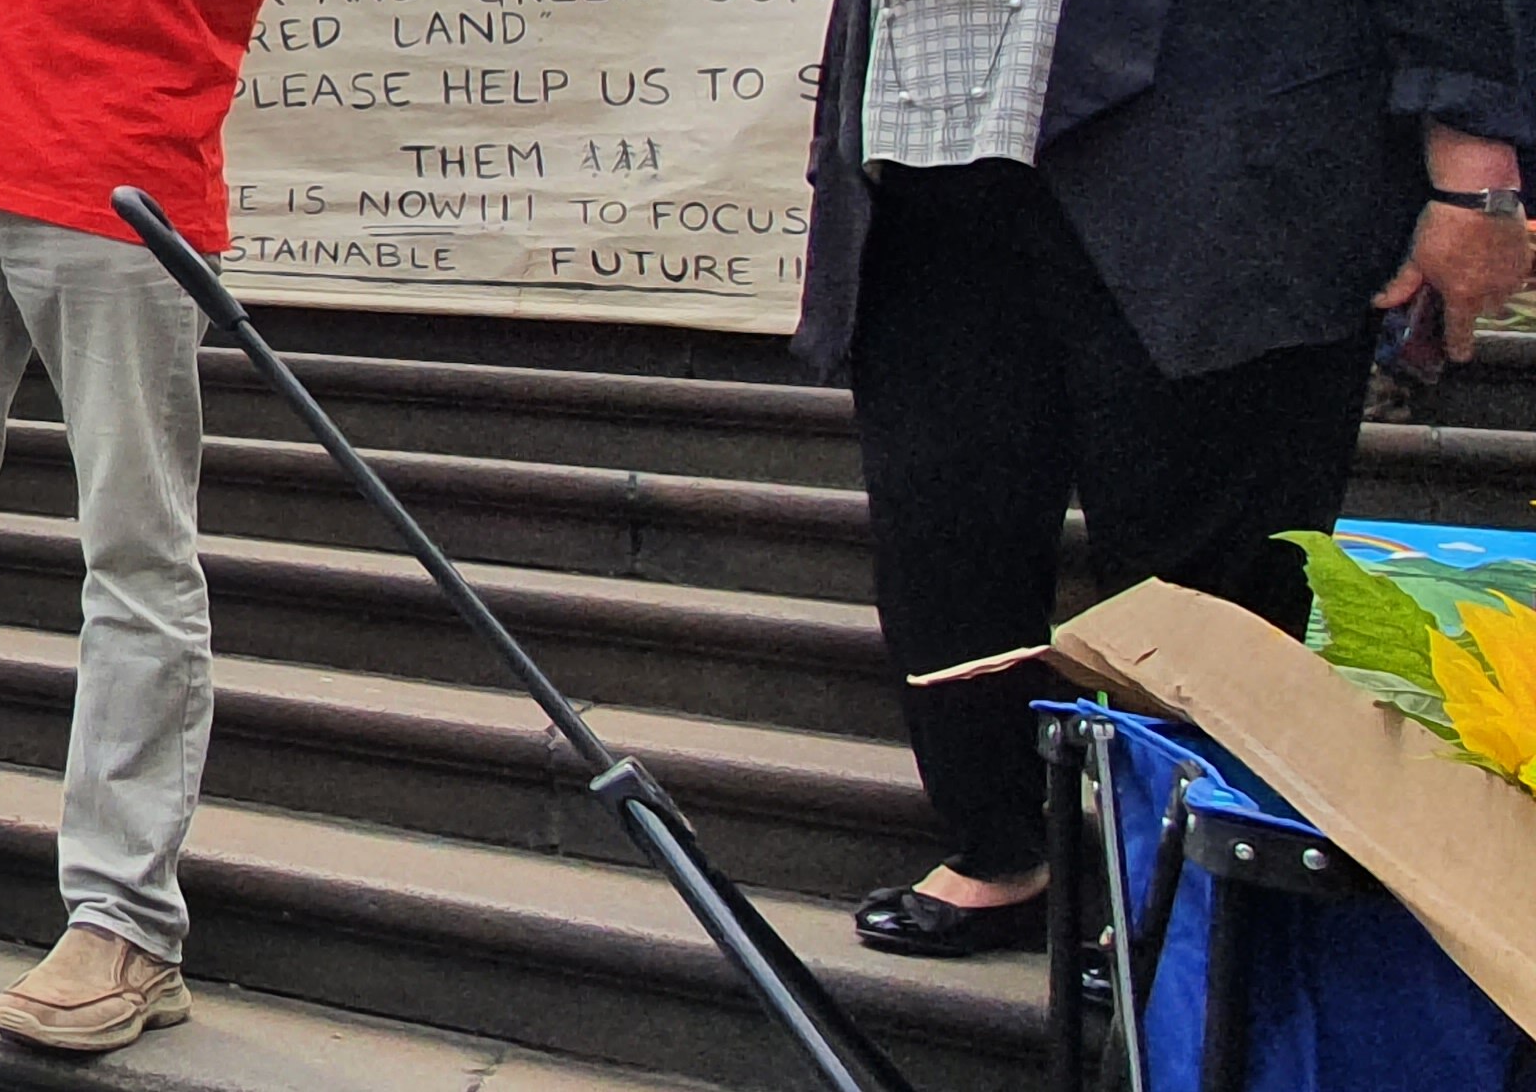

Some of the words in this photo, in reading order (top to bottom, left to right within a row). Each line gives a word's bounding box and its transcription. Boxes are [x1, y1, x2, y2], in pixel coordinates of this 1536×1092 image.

[443, 68, 570, 107] HELP
[600, 70, 670, 107] US
[698, 66, 764, 102] TO
[400, 143, 546, 179] THEM
[288, 186, 327, 217] IS
[569, 198, 628, 227] TO
[652, 200, 808, 236] FOCUS
[550, 247, 756, 286] FUTURE
